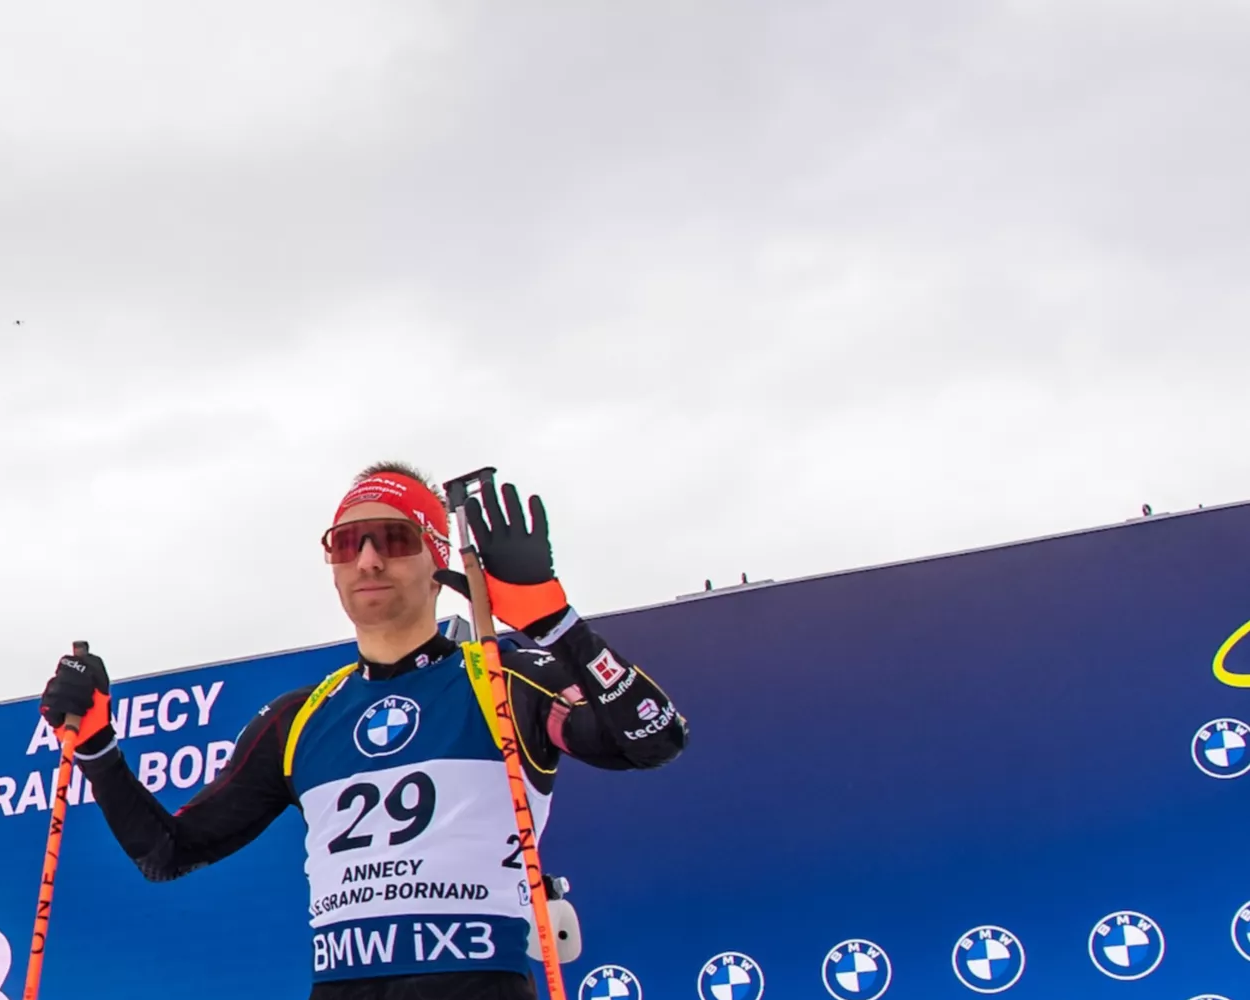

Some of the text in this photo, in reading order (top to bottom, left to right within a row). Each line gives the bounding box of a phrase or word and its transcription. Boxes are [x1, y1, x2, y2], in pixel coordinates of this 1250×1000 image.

[26, 681, 224, 755] ANECY
[365, 699, 414, 720] BMW
[623, 700, 677, 740] tectak
[1199, 722, 1249, 741] BMW
[327, 771, 437, 855] 29
[342, 859, 424, 884] ANNECY
[322, 883, 489, 912] GRAND-BORNAND
[1097, 914, 1152, 937] BMW
[313, 921, 496, 972] BMW iX3
[960, 929, 1013, 950] BMW
[830, 943, 881, 963] BMW
[706, 955, 753, 975] BMW
[586, 969, 632, 987] BMW
